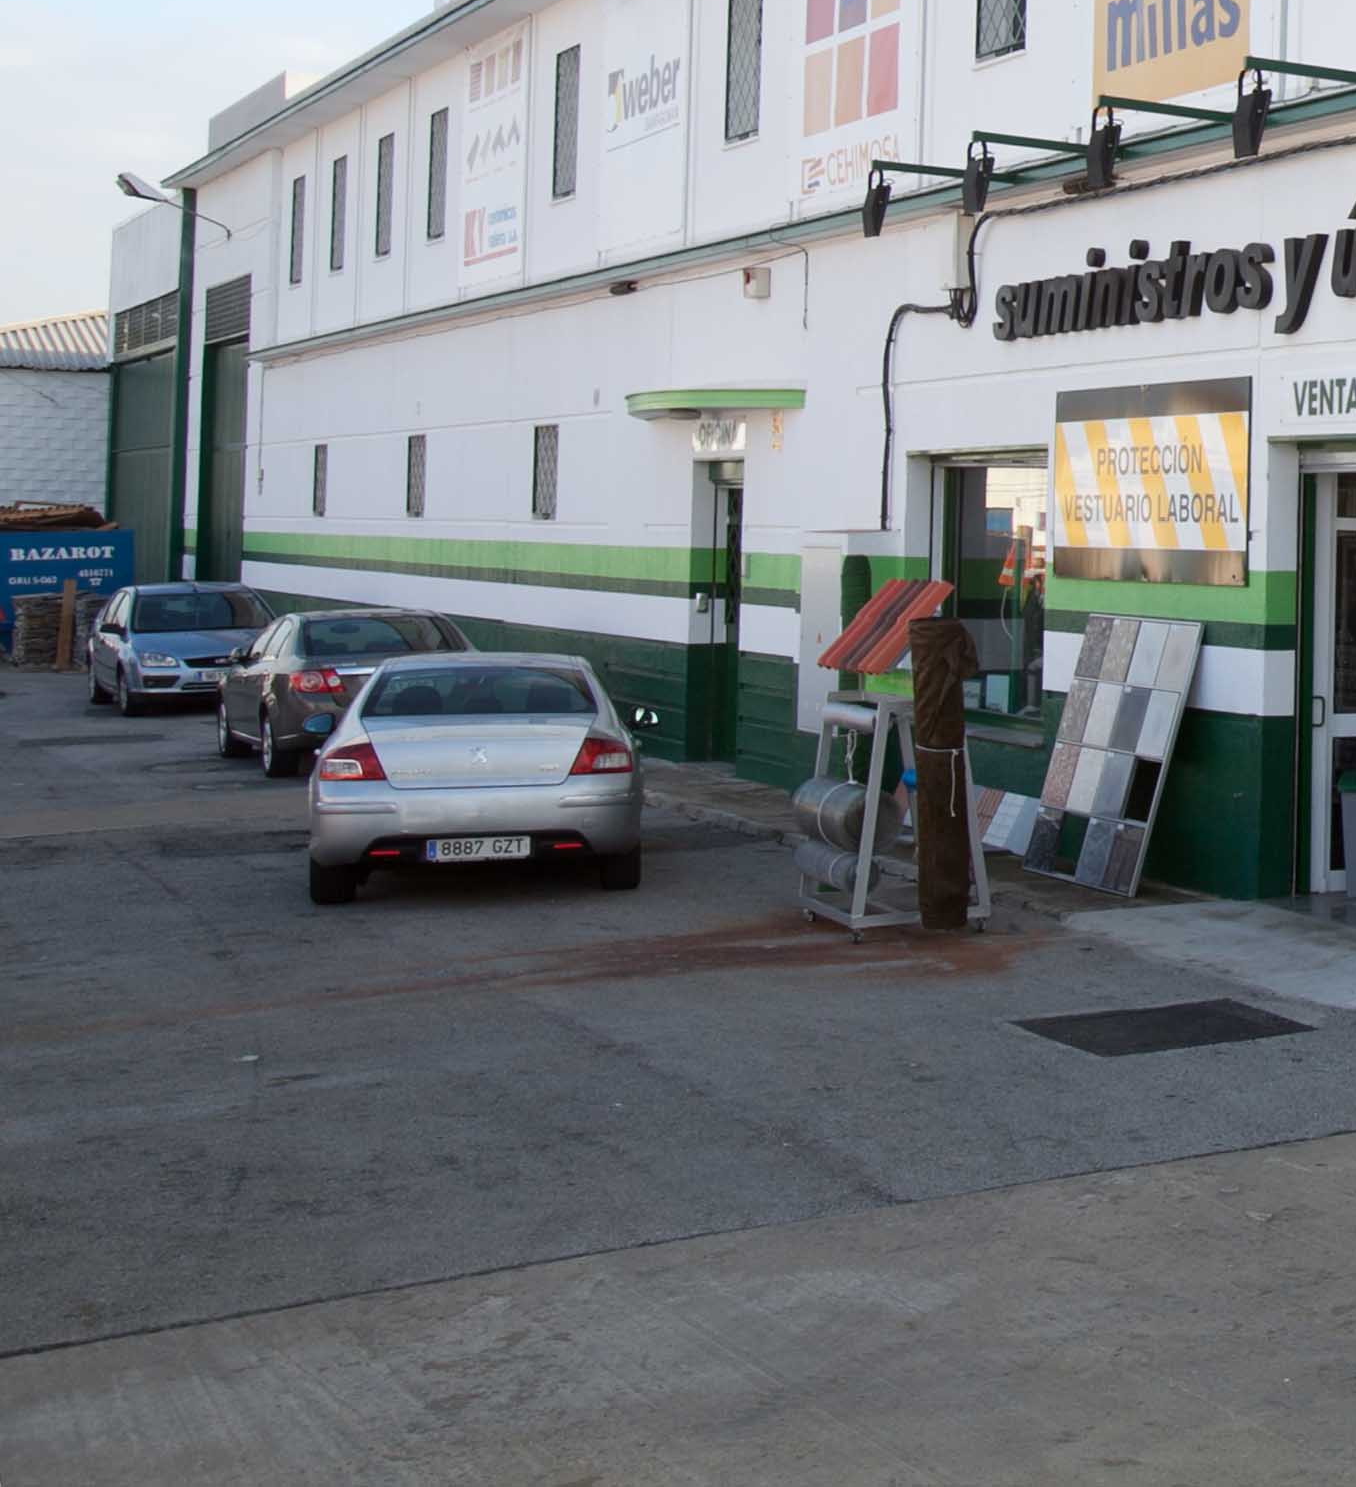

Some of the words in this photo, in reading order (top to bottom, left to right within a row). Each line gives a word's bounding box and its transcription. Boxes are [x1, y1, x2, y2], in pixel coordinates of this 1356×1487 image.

[622, 54, 681, 121] weber
[991, 237, 1274, 342] suministros
[1274, 231, 1329, 335] y
[1096, 436, 1203, 478] PROTECCIÓN
[1064, 493, 1152, 524] VESTUARIO
[1157, 491, 1239, 524] LABORAL
[10, 546, 115, 562] BAZAROT
[440, 840, 484, 857] 8887
[492, 837, 525, 855] GZT
